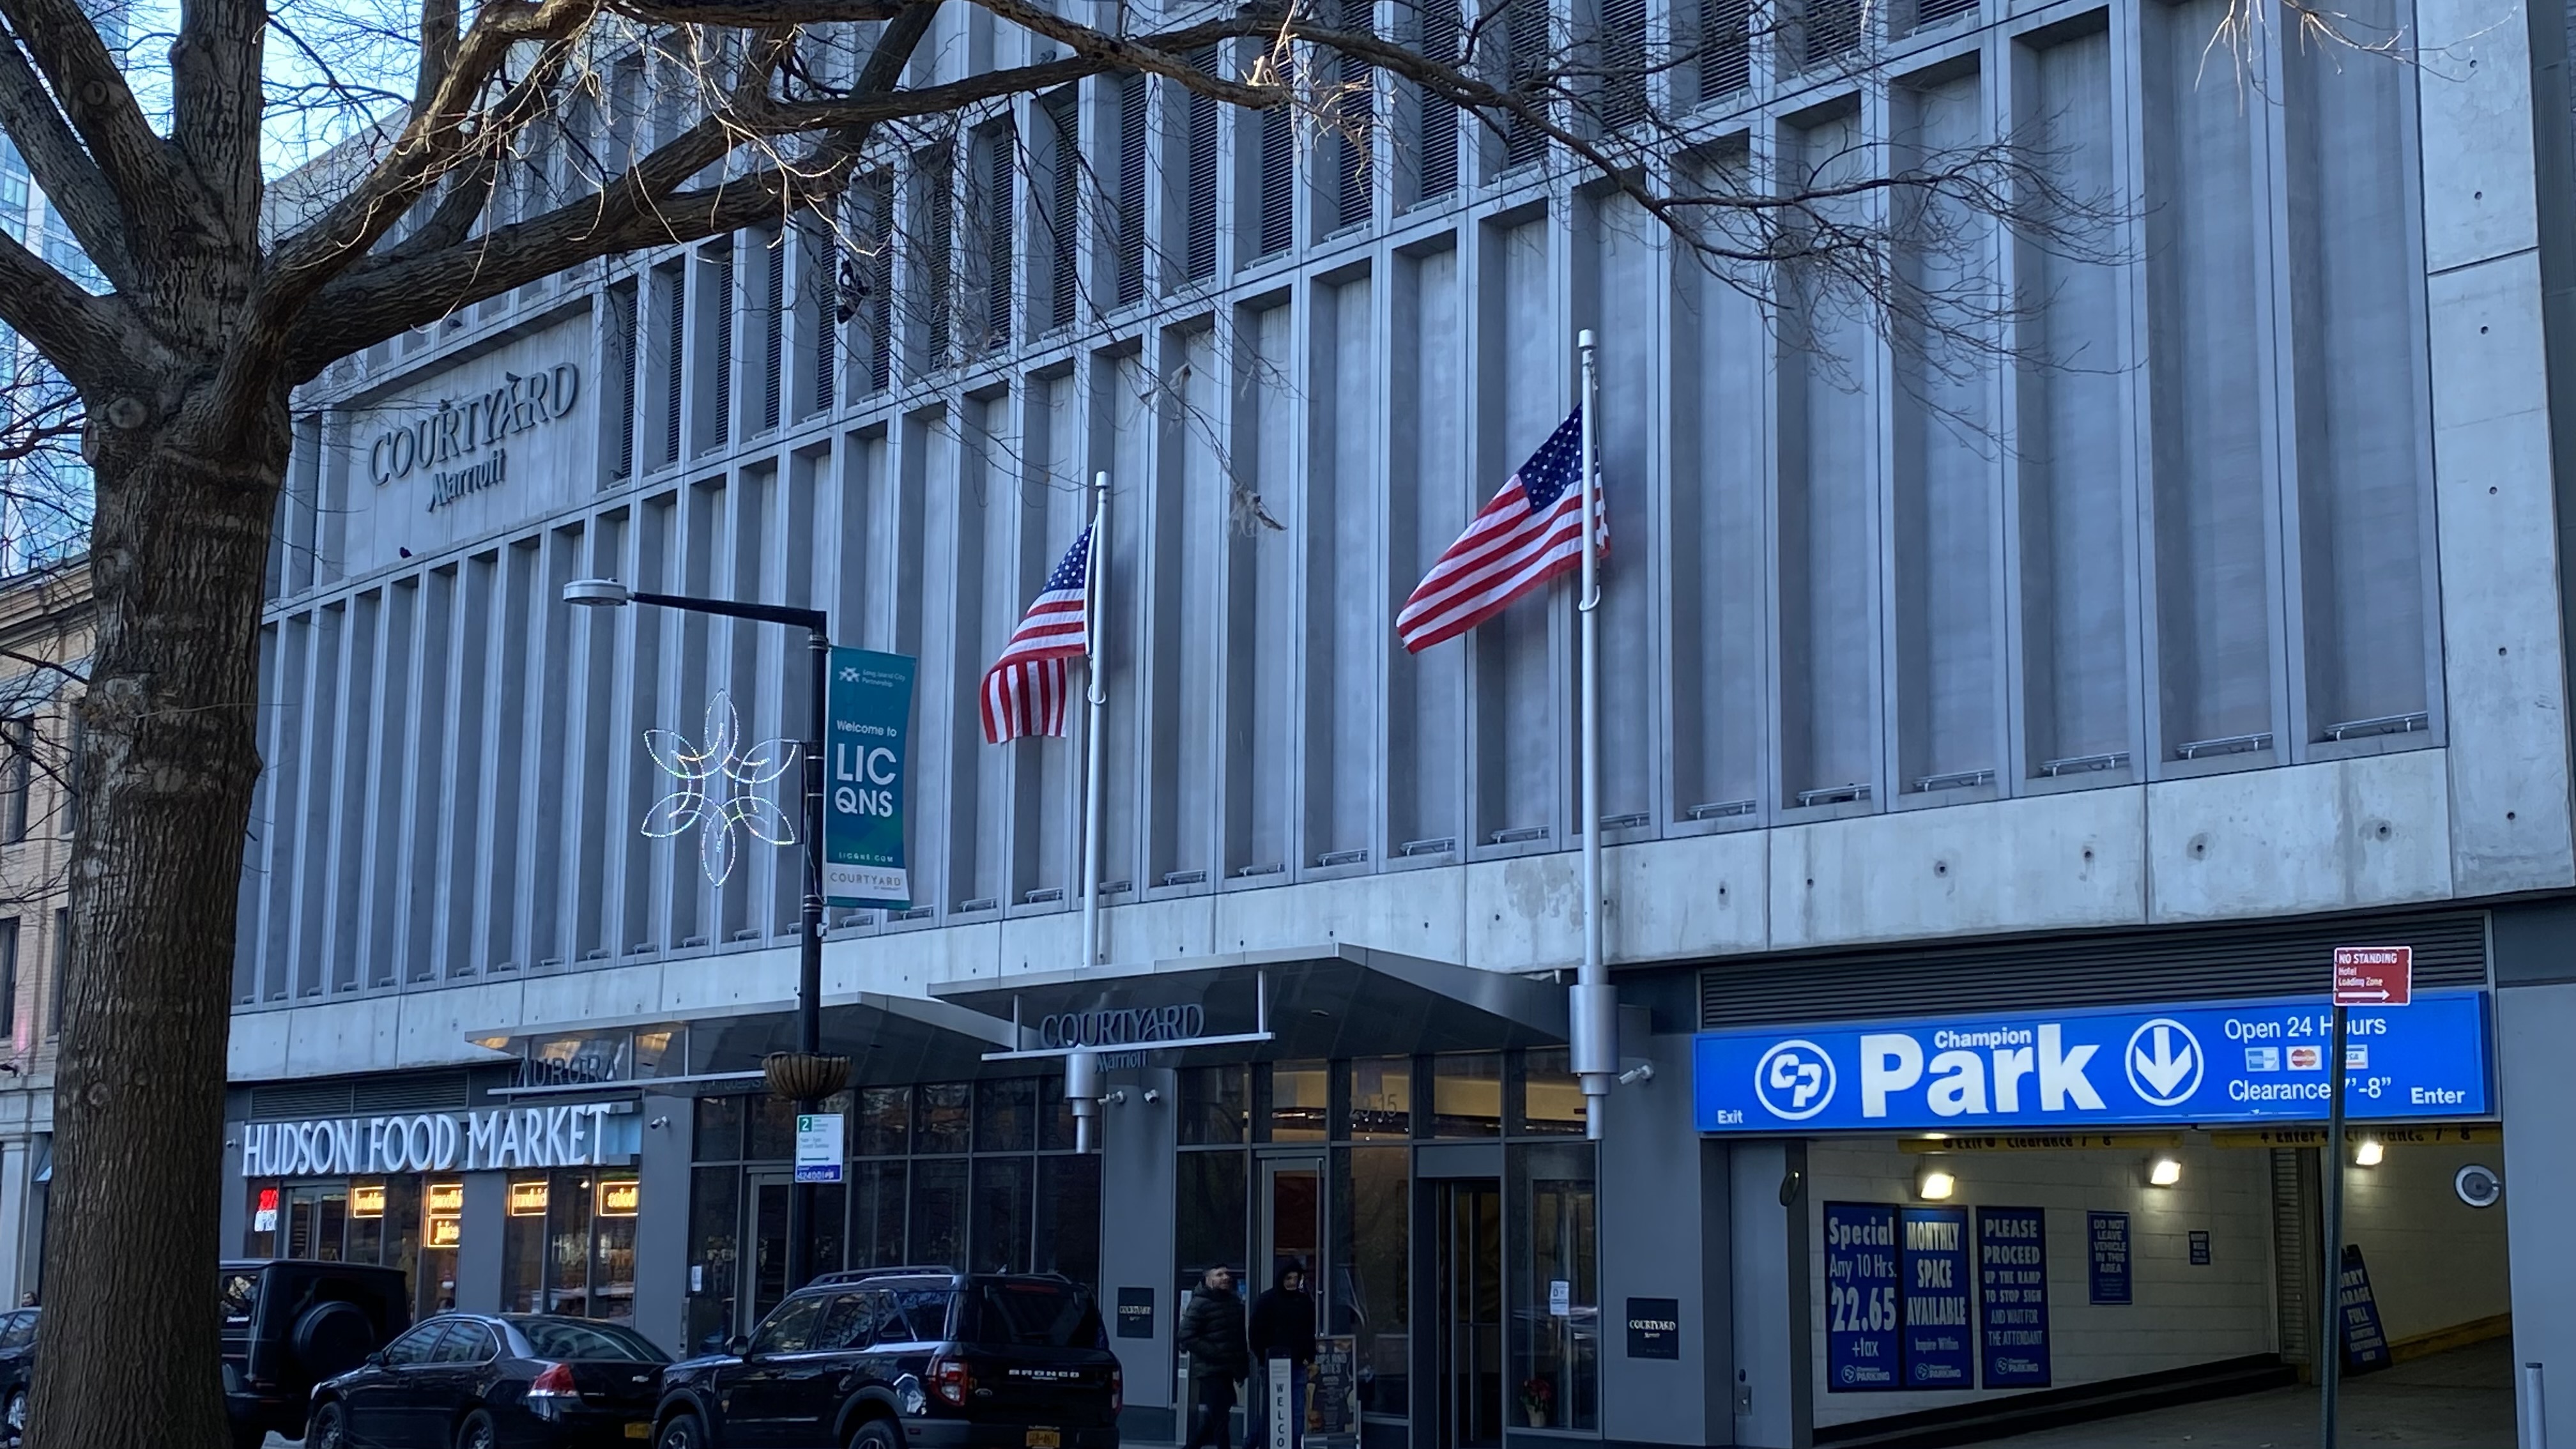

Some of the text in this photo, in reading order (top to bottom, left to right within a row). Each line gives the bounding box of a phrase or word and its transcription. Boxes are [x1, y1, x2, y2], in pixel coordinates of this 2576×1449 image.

[367, 362, 579, 487] COURTYARD
[427, 448, 507, 512] Marriott
[836, 720, 897, 737] Welcome to
[836, 743, 897, 785] LIC
[835, 786, 893, 817] QNS
[830, 872, 901, 886] COURTYARD
[2339, 953, 2397, 963] NO STANDING
[1039, 1003, 1204, 1048] COURTYARD
[2225, 1015, 2388, 1043] Open 24 Hurs
[1933, 1027, 2032, 1050] Champion
[516, 1054, 617, 1087] AURORA
[1095, 1050, 1148, 1073] Marriott
[1860, 1023, 2108, 1118] Park
[2228, 1078, 2332, 1102] Clearance
[2411, 1087, 2465, 1105] Enter
[1717, 1110, 1744, 1124] Exit
[241, 1103, 611, 1177] HUDSON FOOD MARKET
[1829, 1216, 1894, 1250] Special
[1984, 1218, 2038, 1238] PLEASE
[2093, 1219, 2125, 1229] DO NOT
[1906, 1222, 1959, 1251] MONTHLY
[2097, 1230, 2123, 1241] LEAVE
[1983, 1245, 2041, 1265] PROCEED
[2094, 1241, 2127, 1252] VEHICLE
[2096, 1252, 2105, 1262] IN
[1829, 1254, 1897, 1283] Any 10 Hrs.
[1917, 1259, 1952, 1289] SPACE
[1984, 1271, 2041, 1284] UP THE RAMP
[2100, 1262, 2122, 1273] AREA
[1985, 1289, 2042, 1303] TO STOP SIGN
[2341, 1286, 2372, 1307] ARAGE
[1831, 1286, 1896, 1332] 22.65
[1906, 1296, 1966, 1326] AVAILABLE
[2025, 1308, 2039, 1324] FOR
[2347, 1307, 2370, 1324] FULL
[1851, 1337, 1879, 1358] +tax
[1988, 1331, 2002, 1347] THE
[1009, 1369, 1079, 1378] BRONCO
